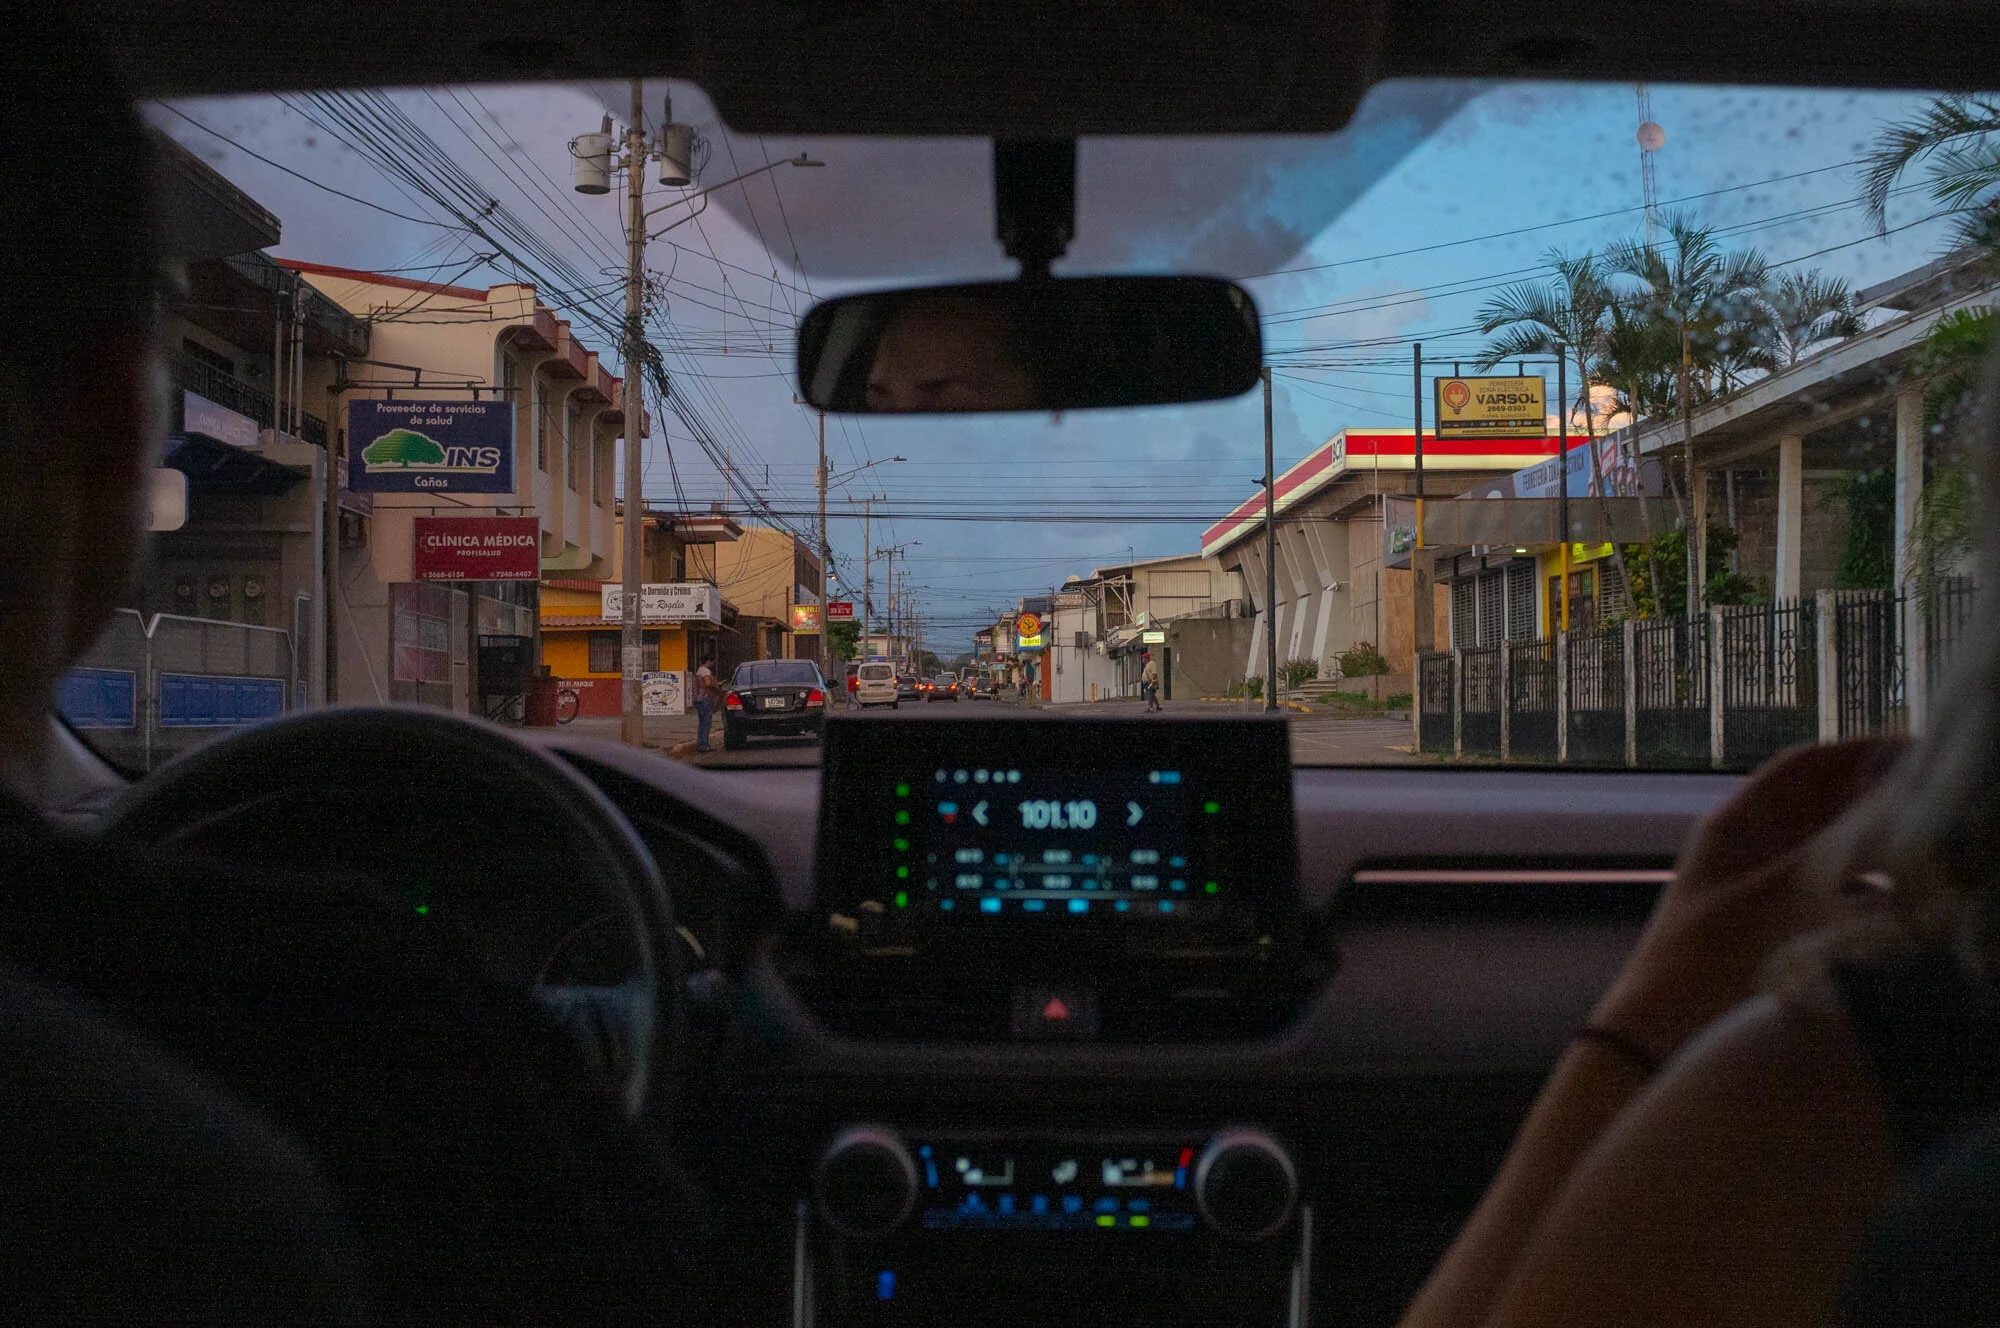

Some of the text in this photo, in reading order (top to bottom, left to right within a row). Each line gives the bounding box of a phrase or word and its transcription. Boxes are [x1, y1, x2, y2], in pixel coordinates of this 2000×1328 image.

[1476, 393, 1539, 405] VARSOL
[377, 403, 486, 414] Proveedor de servicios
[410, 416, 453, 425] de salud
[446, 447, 501, 468] INS
[414, 476, 448, 488] Cañas
[427, 532, 535, 547] CLÍNICA MÉDICA
[648, 586, 670, 596] Dormida
[657, 599, 685, 612] Rogelio
[1018, 799, 1098, 830] 101.10
